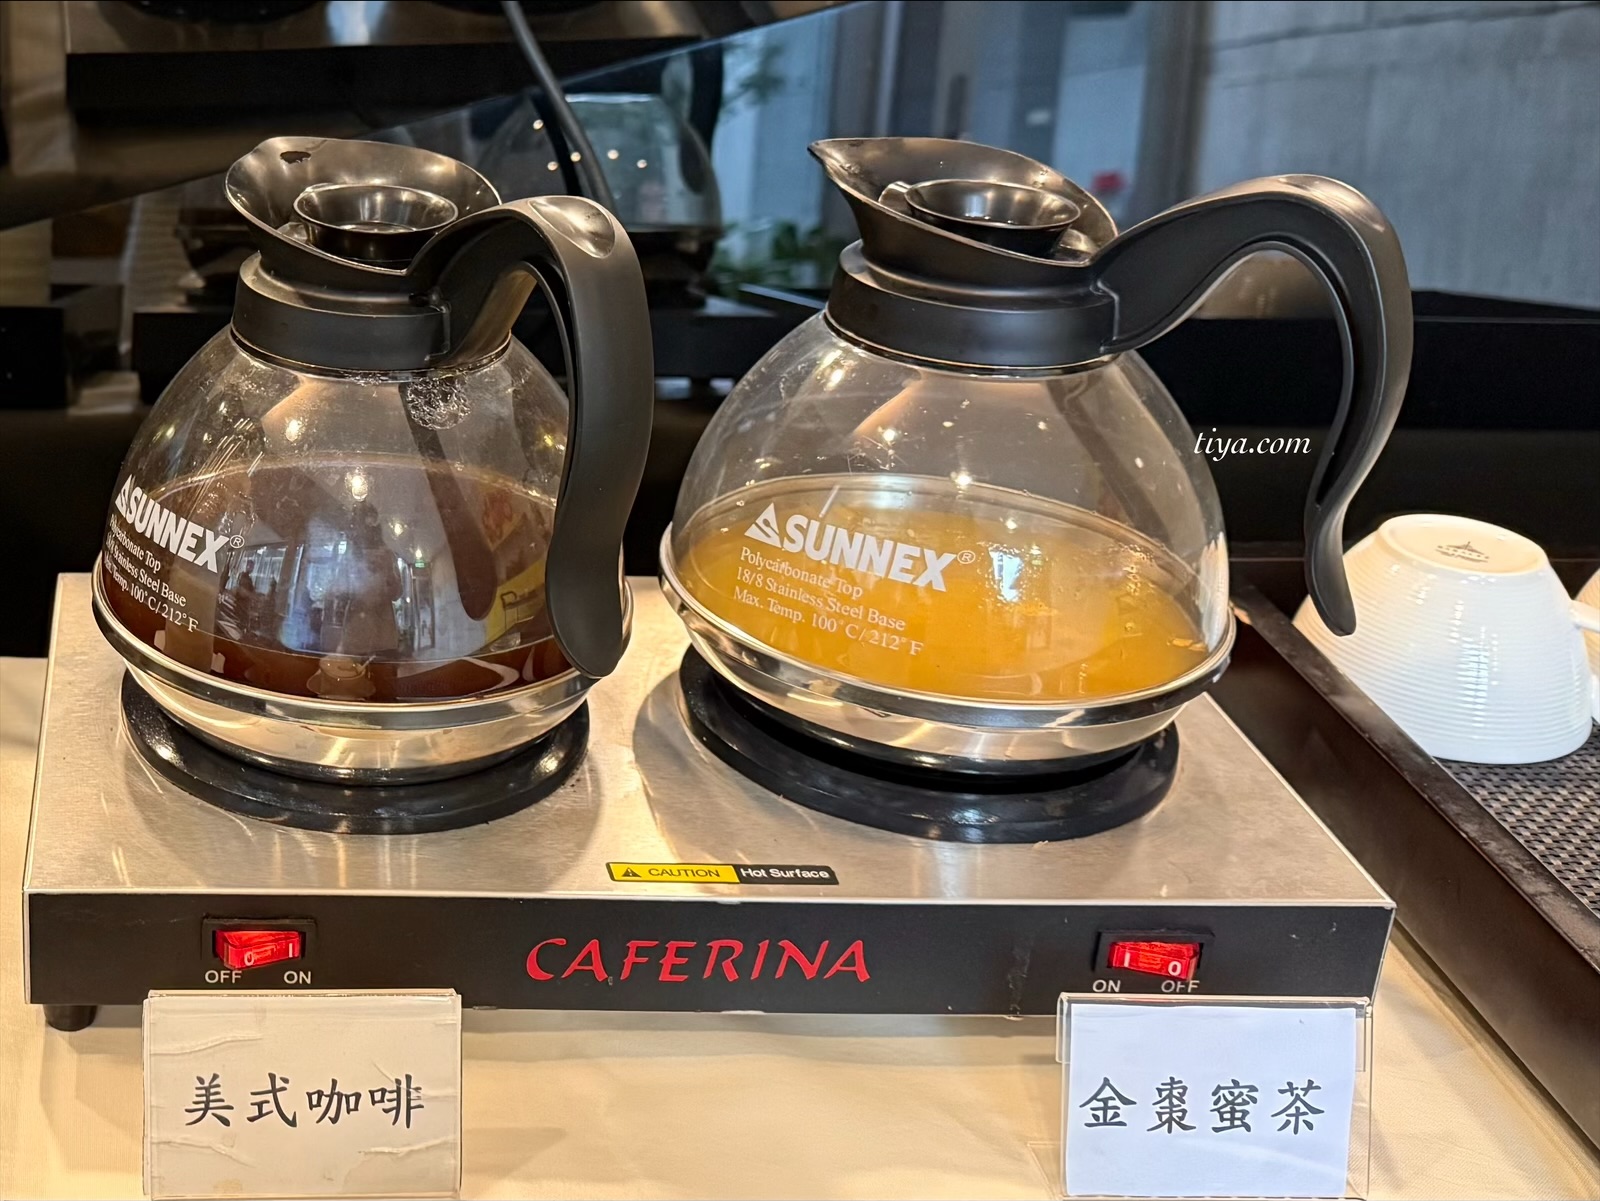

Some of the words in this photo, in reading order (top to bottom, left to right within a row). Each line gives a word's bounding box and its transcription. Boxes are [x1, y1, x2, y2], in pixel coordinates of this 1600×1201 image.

[145, 550, 161, 574] Top
[740, 546, 831, 589] Polycarbonate
[836, 577, 863, 600] Top
[139, 568, 161, 594] Steel
[161, 582, 187, 607] Base
[734, 585, 763, 608] Max.
[767, 597, 805, 624] Temp.
[737, 566, 764, 588] 18/8
[765, 577, 824, 608] Stainless
[826, 597, 864, 620] Steel
[867, 607, 906, 631] Base
[648, 867, 720, 878] CAUTION
[741, 867, 768, 878] Hot
[771, 868, 831, 879] Surface
[204, 970, 242, 984] OFF
[283, 970, 311, 984] ON
[526, 938, 871, 982] CAFERINA
[1092, 979, 1121, 993] ON
[1161, 980, 1200, 993] OFF
[184, 1072, 425, 1128] 美式咖啡
[1079, 1076, 1325, 1135] 金棗蜜茶
